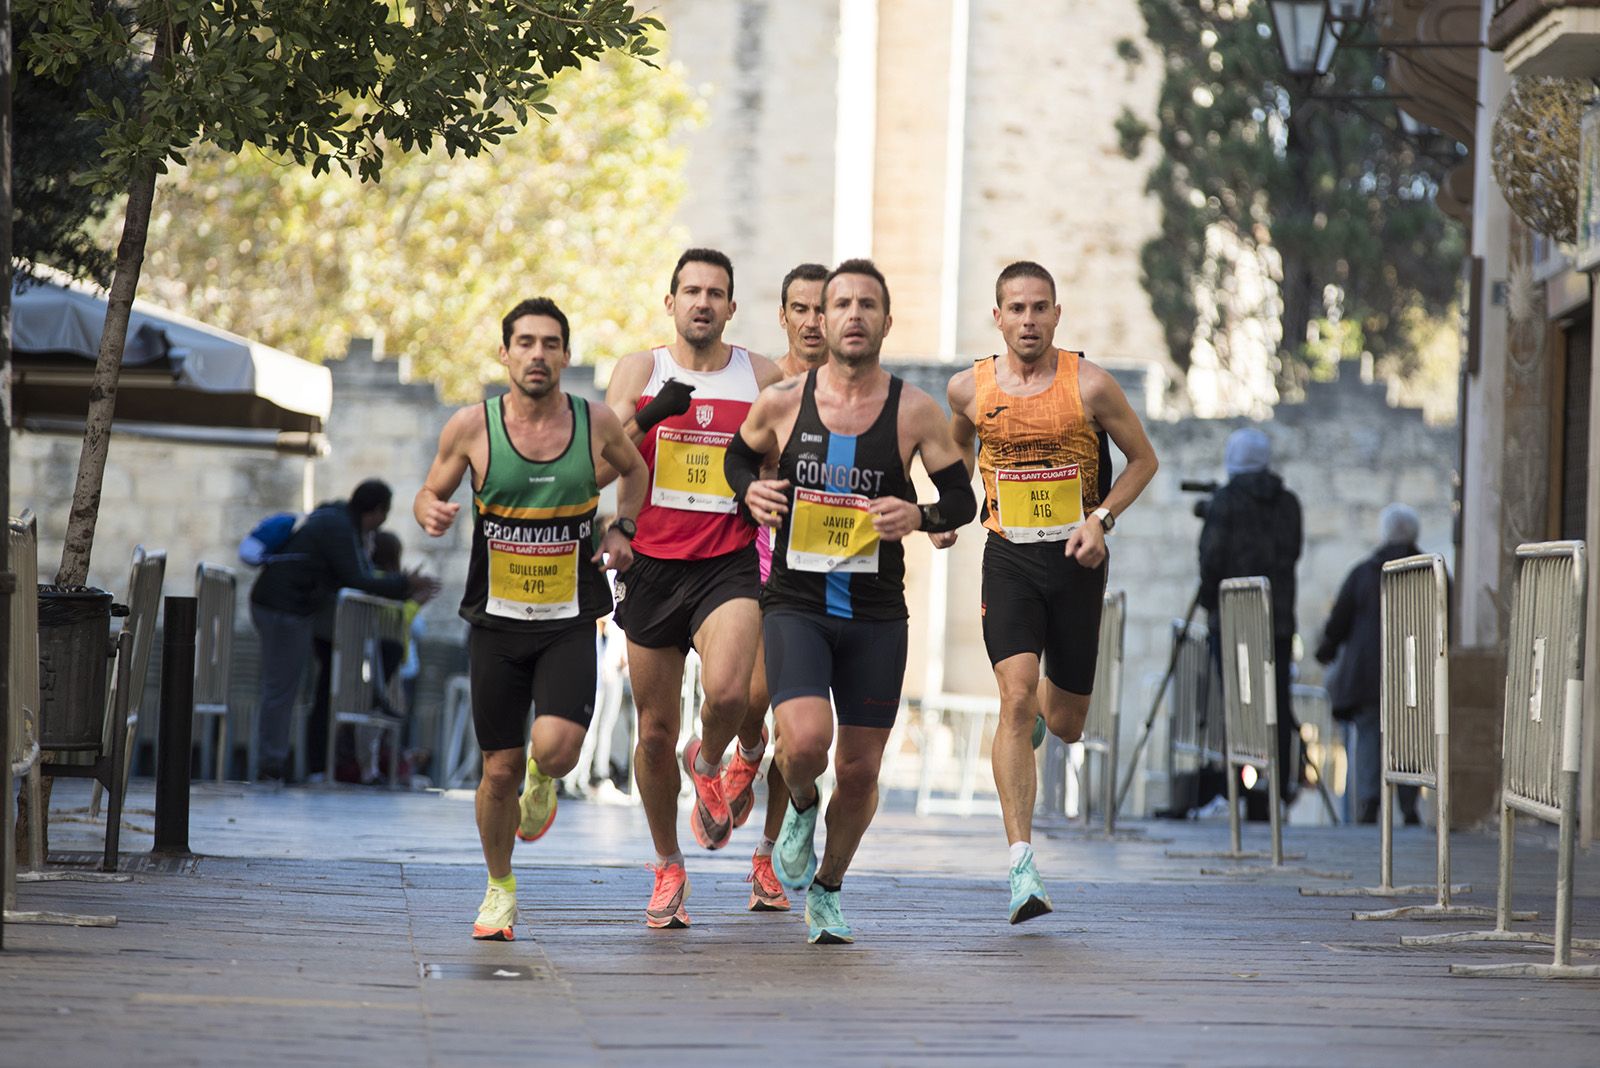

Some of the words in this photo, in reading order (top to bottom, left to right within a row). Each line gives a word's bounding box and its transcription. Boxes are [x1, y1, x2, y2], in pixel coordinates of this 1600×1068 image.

[660, 432, 682, 440] MITJA
[683, 434, 703, 443] SANT
[703, 436, 729, 445] CUGAT
[687, 468, 707, 484] 513
[796, 460, 885, 492] CONGOST
[999, 472, 1020, 480] MITJA
[1021, 472, 1041, 480] SANT
[1041, 470, 1067, 479] CUGAT
[799, 491, 822, 502] MITJA
[823, 495, 845, 505] SANT
[1030, 490, 1050, 501] ALEX
[1033, 504, 1052, 518] 416
[823, 515, 855, 529] JAVIER
[483, 520, 570, 543] CERDANYOLA
[828, 530, 850, 547] 740
[492, 543, 515, 552] MITJA
[516, 544, 537, 554] SANT
[537, 544, 564, 554] CUGAT
[509, 563, 558, 577] GUILLERMO
[522, 579, 545, 594] 470
